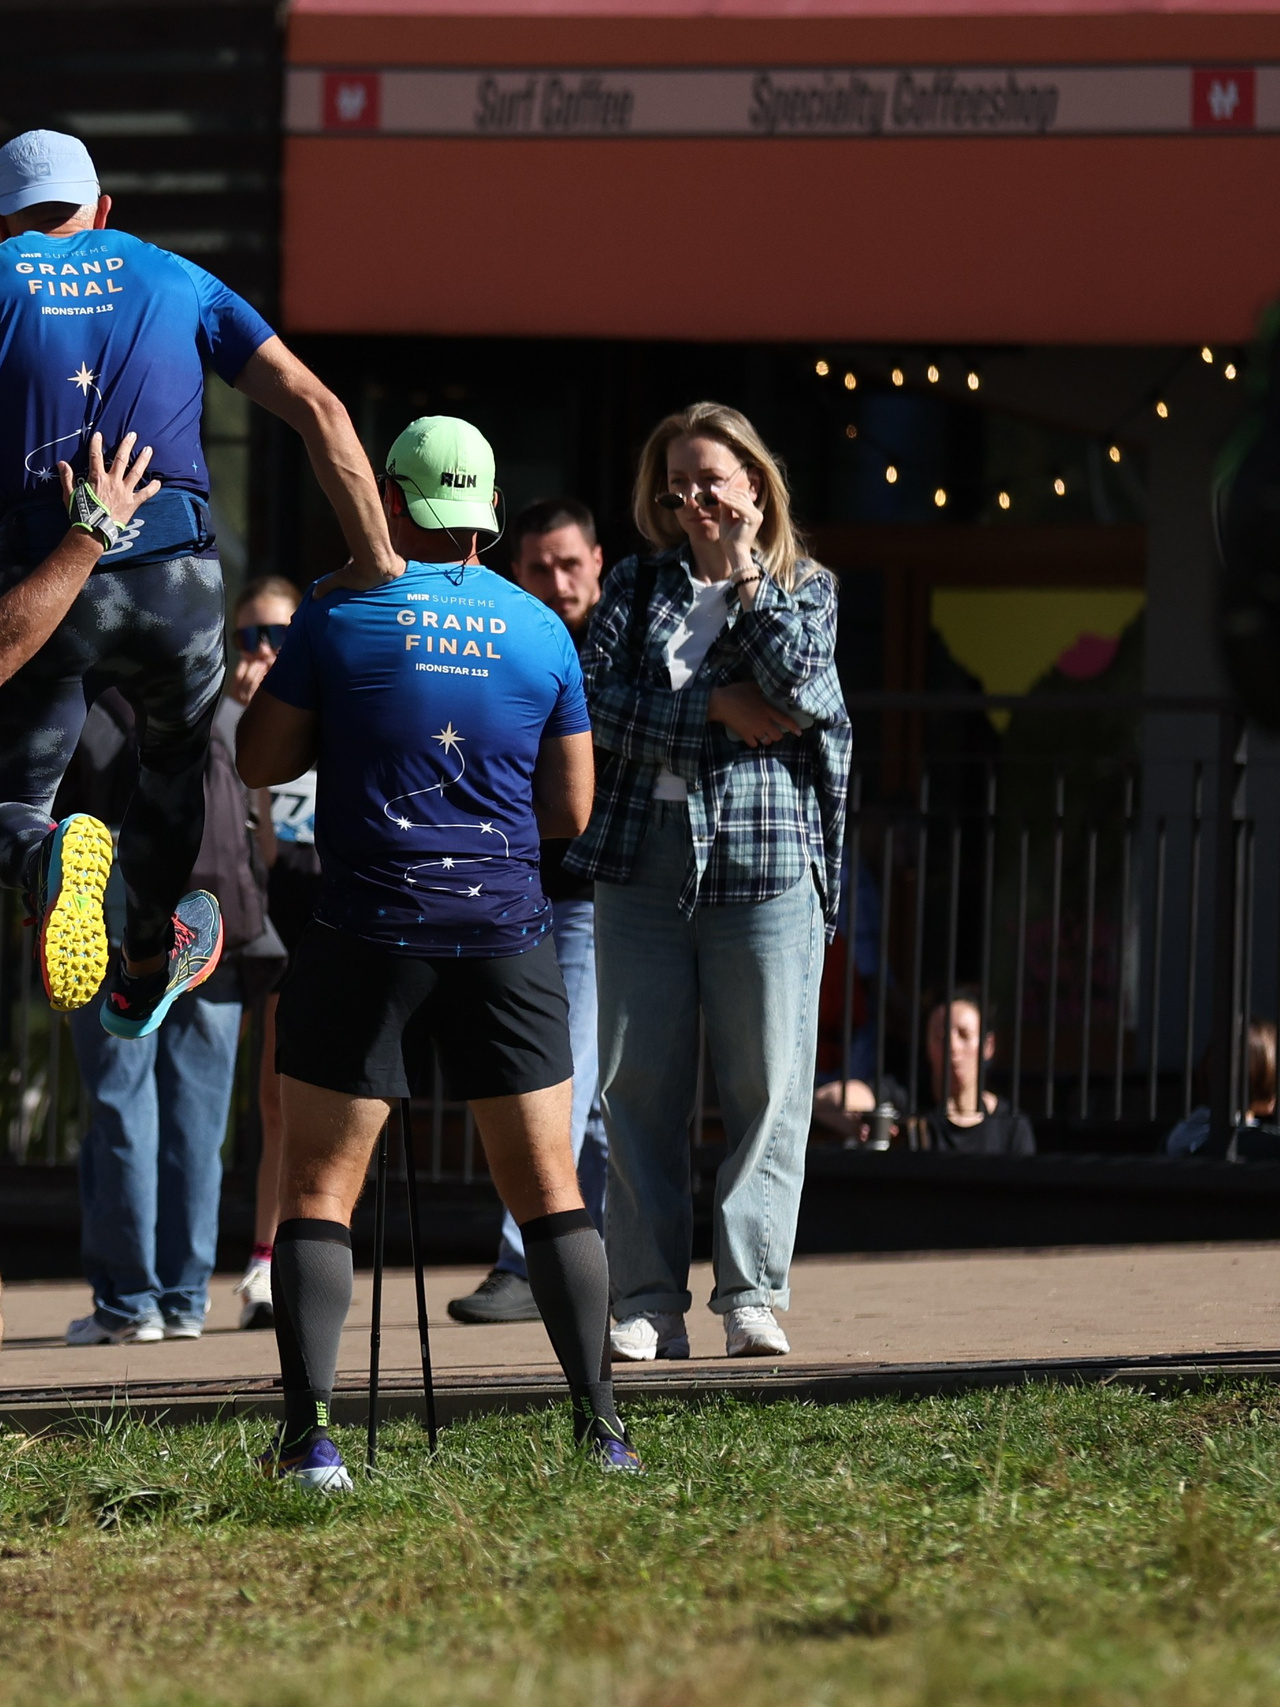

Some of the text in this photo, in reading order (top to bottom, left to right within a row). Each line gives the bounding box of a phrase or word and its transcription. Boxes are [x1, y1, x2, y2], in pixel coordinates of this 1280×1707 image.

[474, 75, 634, 130] Surf Coffee
[748, 71, 1058, 135] Specialty Coffeeshop
[44, 245, 109, 259] SUPREME
[15, 257, 124, 276] GRAND
[28, 278, 123, 297] FINAL
[41, 304, 114, 315] IRONSTAR 113
[440, 472, 477, 488] RUN
[407, 593, 495, 608] MIR SUPREME
[396, 609, 507, 634] GRAND
[405, 634, 502, 660] FINAL
[415, 663, 489, 677] IRONSTAR 113
[315, 1400, 328, 1427] BUFF
[580, 1396, 594, 1418] BUFF
